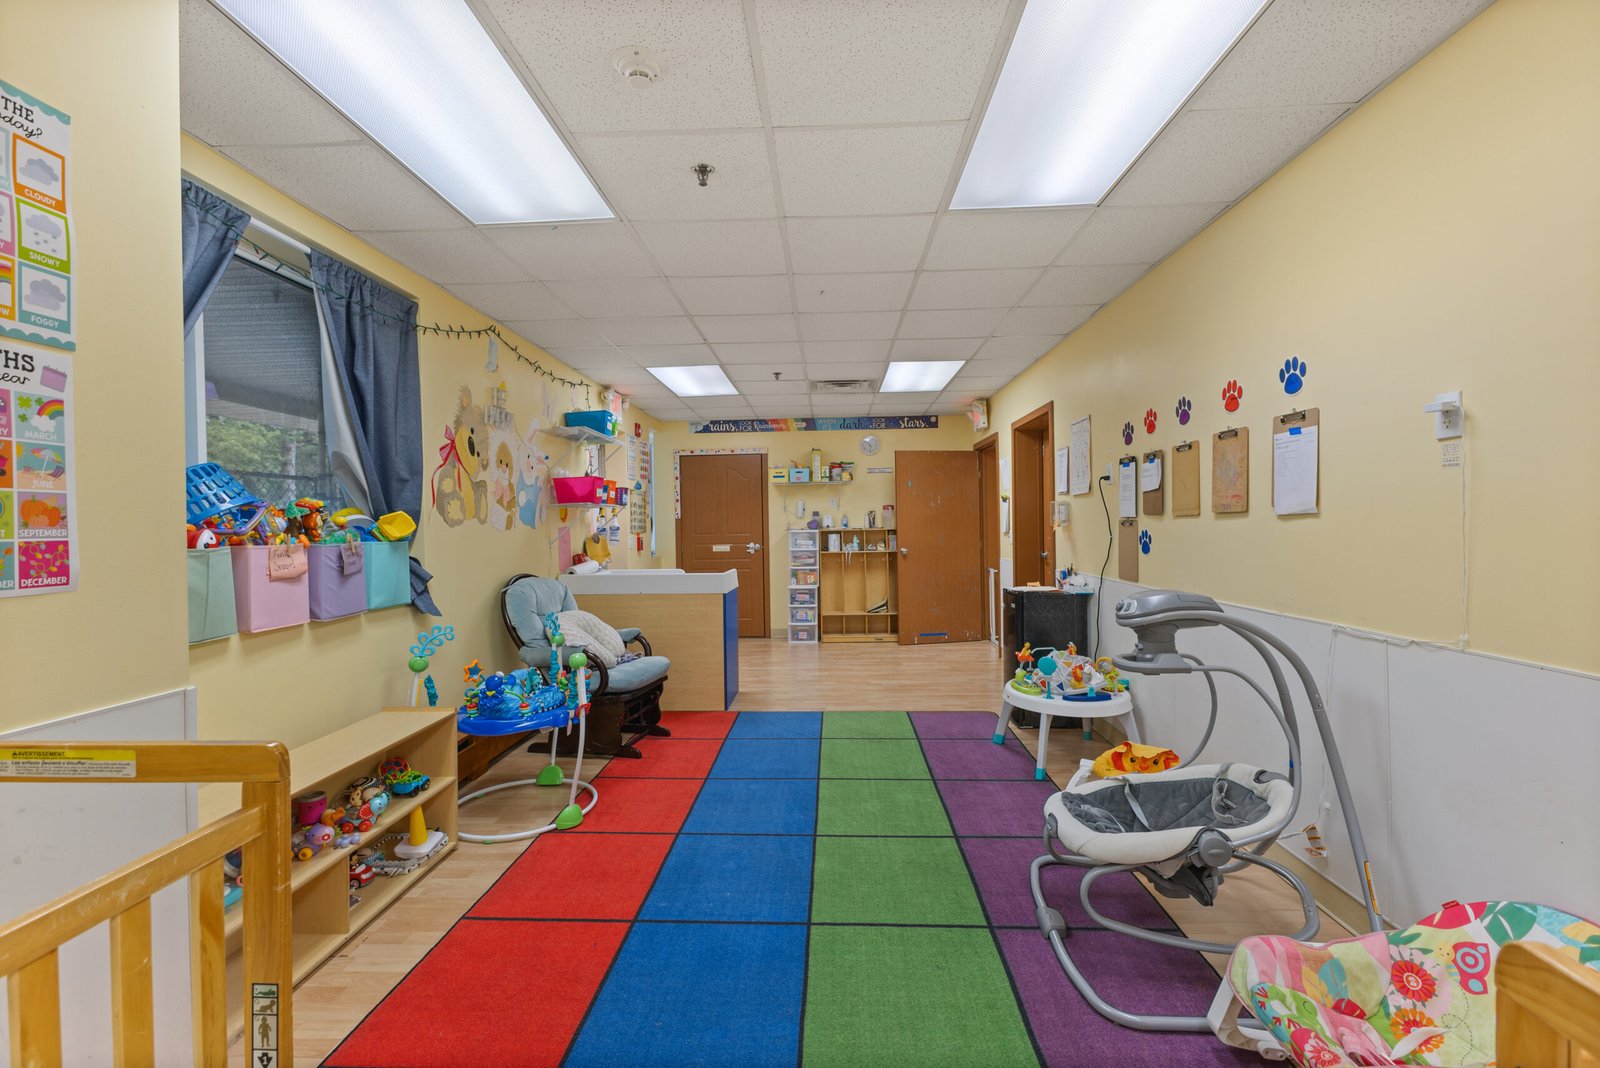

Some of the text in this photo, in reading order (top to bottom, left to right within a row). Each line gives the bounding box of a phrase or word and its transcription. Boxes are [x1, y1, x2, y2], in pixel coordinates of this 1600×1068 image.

[1, 95, 34, 124] THE
[24, 188, 57, 207] CLOUDY
[29, 251, 60, 268] SNOWY
[31, 315, 59, 329] FOGGY
[0, 349, 35, 373] HS
[0, 372, 30, 385] ear
[24, 430, 57, 441] MARCH
[32, 480, 54, 489] JUNE
[18, 529, 67, 537] SEPTEMBER
[21, 576, 68, 587] DECEMBER
